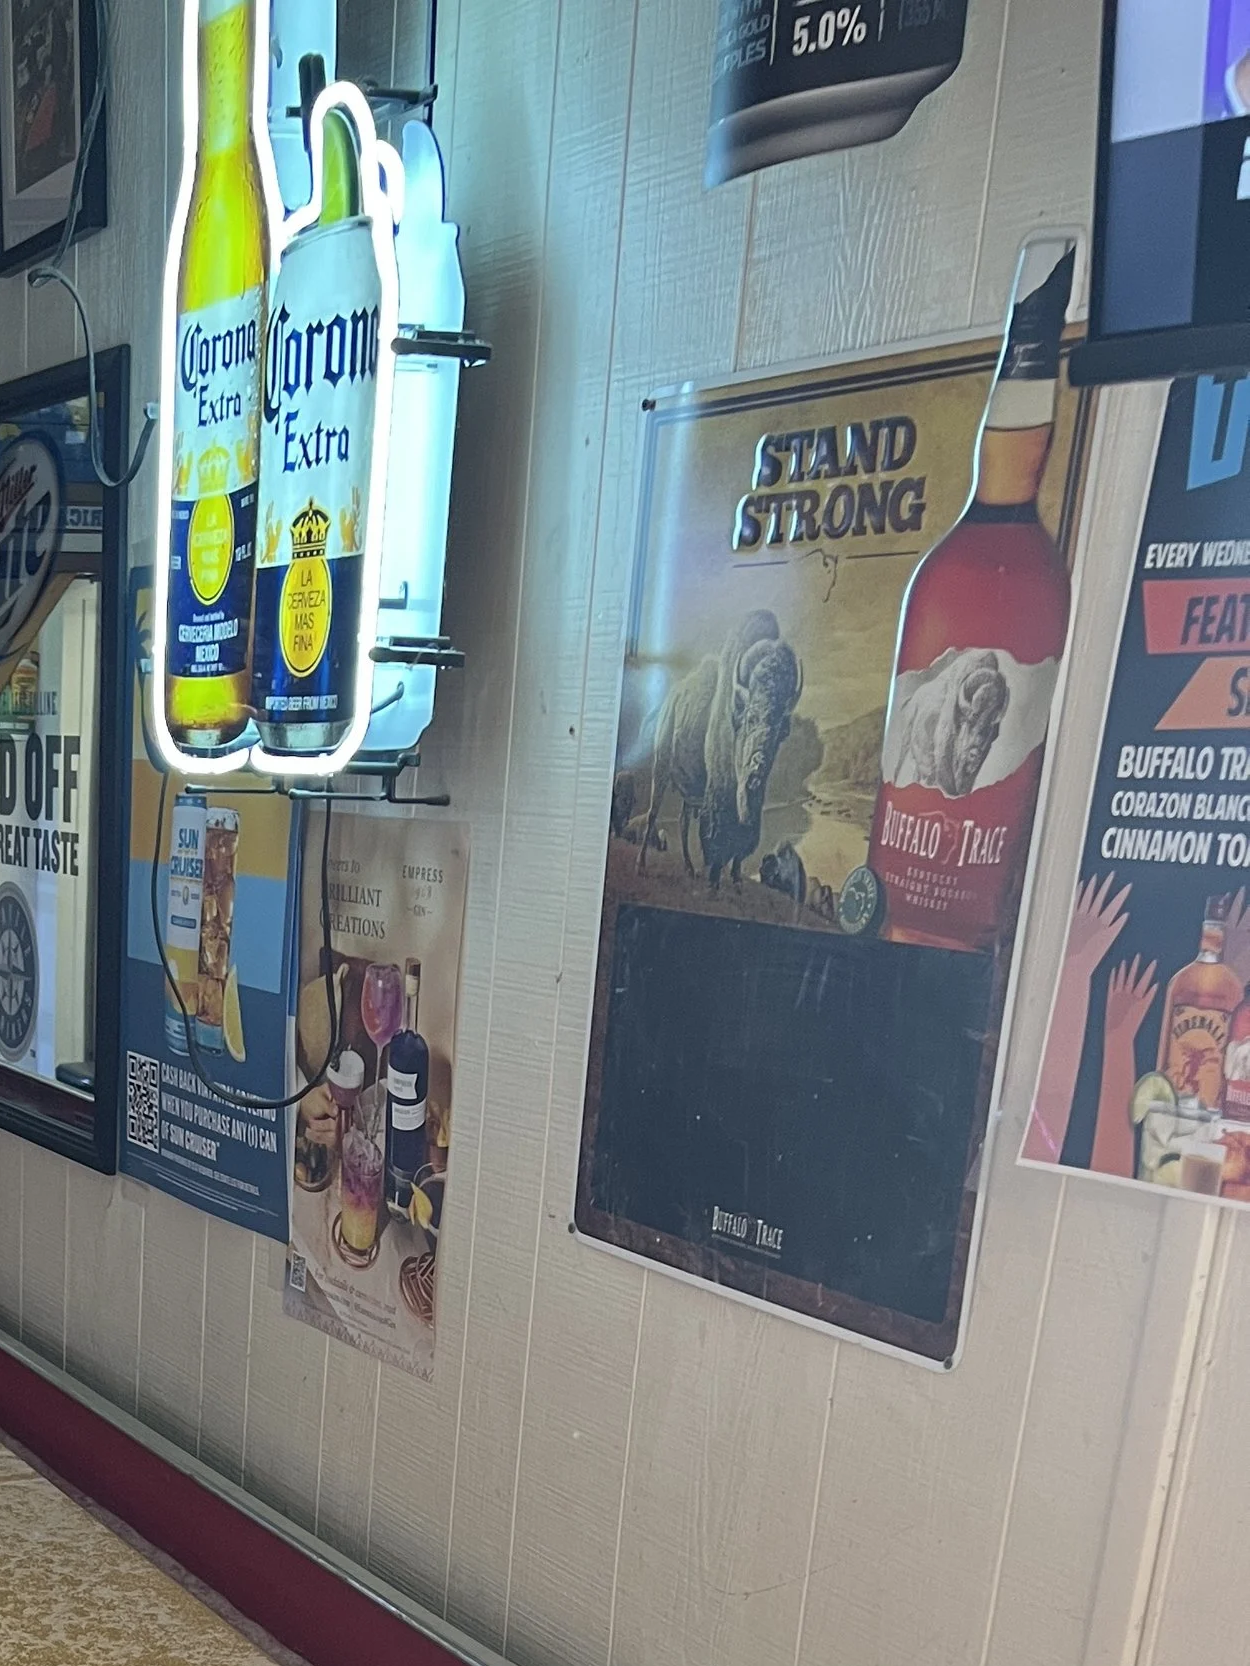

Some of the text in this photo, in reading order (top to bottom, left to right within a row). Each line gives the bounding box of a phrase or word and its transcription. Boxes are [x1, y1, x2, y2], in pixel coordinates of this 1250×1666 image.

[792, 5, 867, 56] 5.0%
[181, 319, 256, 398] Corona
[197, 384, 241, 427] Extra
[282, 408, 349, 474] Extra
[751, 415, 917, 491] STAND
[731, 476, 927, 551] STRONG
[1144, 540, 1201, 569] EVERY
[301, 569, 313, 587] LA
[294, 612, 314, 631] MAS
[293, 634, 313, 652] FINA
[25, 732, 81, 823] OFF
[1116, 745, 1215, 781] BUFFALO
[1110, 790, 1193, 819] CORAZON
[31, 827, 79, 876] TASTE
[178, 828, 200, 849] SUN
[880, 800, 1008, 867] BUFFALO TRACE
[1101, 826, 1213, 865] CINNAMON
[170, 856, 203, 879] CRUISER
[402, 864, 444, 883] EMPRESS
[328, 882, 383, 907] RILLIANT
[161, 1062, 178, 1088] CASH
[179, 1068, 197, 1095] BACK
[161, 1091, 180, 1117] WHEN
[180, 1097, 194, 1122] YOU
[194, 1102, 231, 1137] PURCHASE
[231, 1117, 247, 1143] ANY
[259, 1127, 278, 1153] CAN
[161, 1119, 171, 1140] OF
[170, 1123, 185, 1147] SUN
[712, 1205, 748, 1239] BUFFALO
[756, 1219, 784, 1250] TRACE
